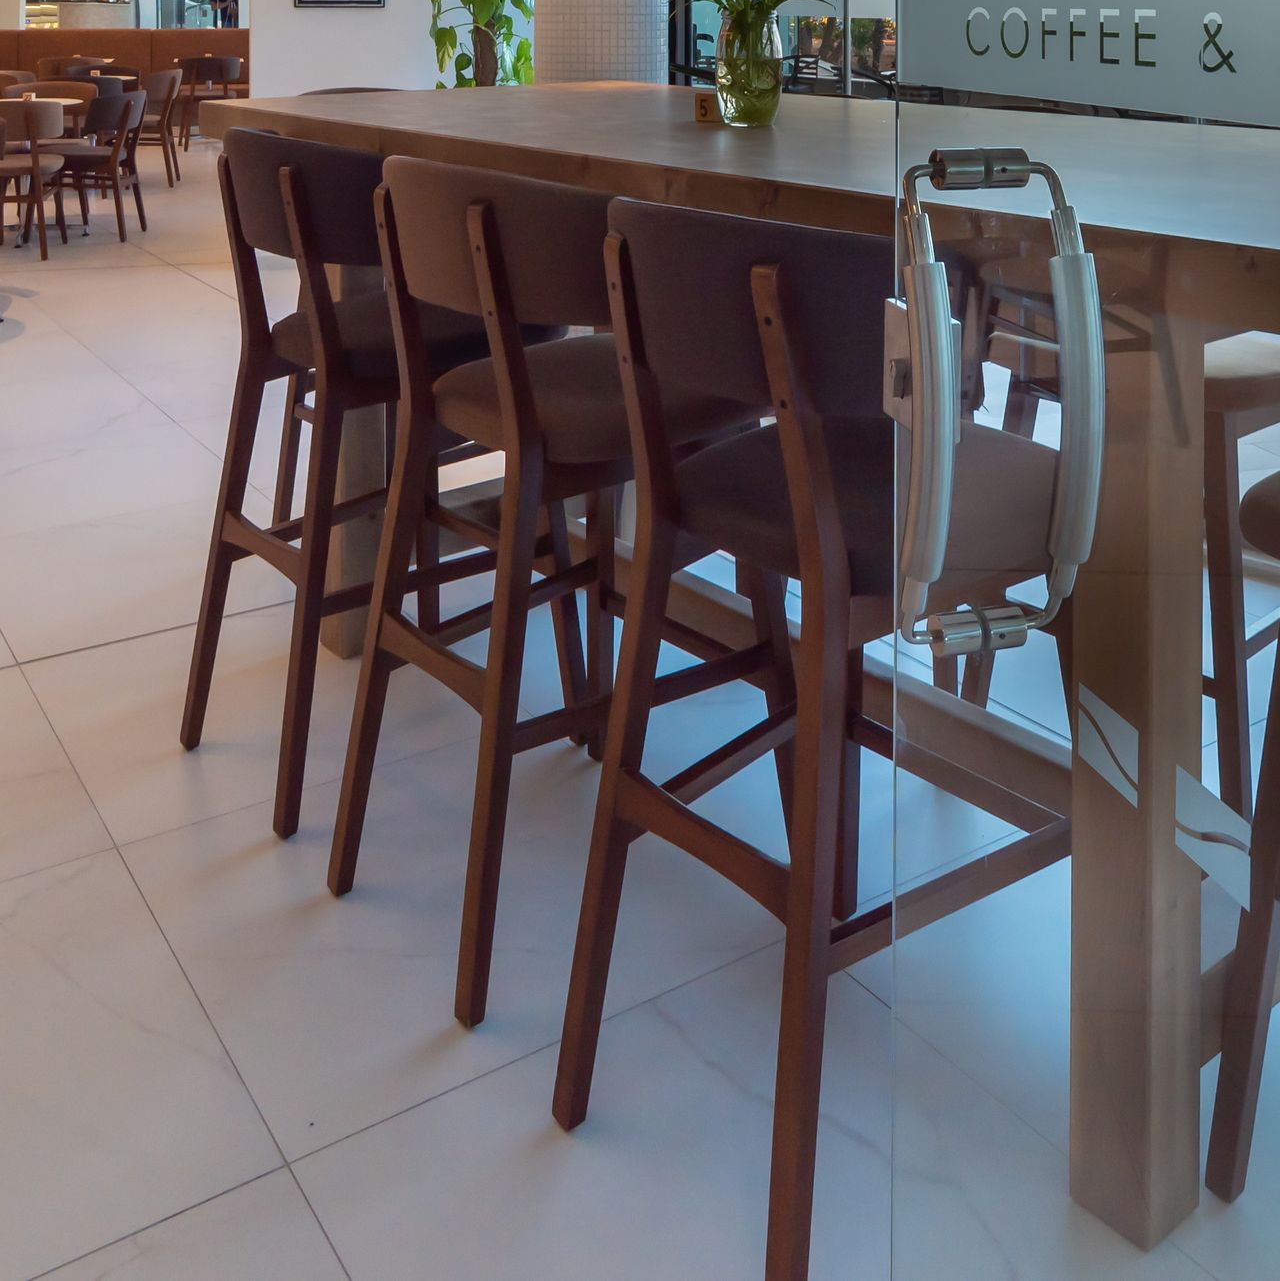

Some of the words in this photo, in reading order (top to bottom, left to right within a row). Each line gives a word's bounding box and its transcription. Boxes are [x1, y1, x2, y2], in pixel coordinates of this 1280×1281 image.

[965, 6, 1157, 68] COFFEE
[1198, 11, 1238, 73] &
[700, 99, 708, 117] 5
